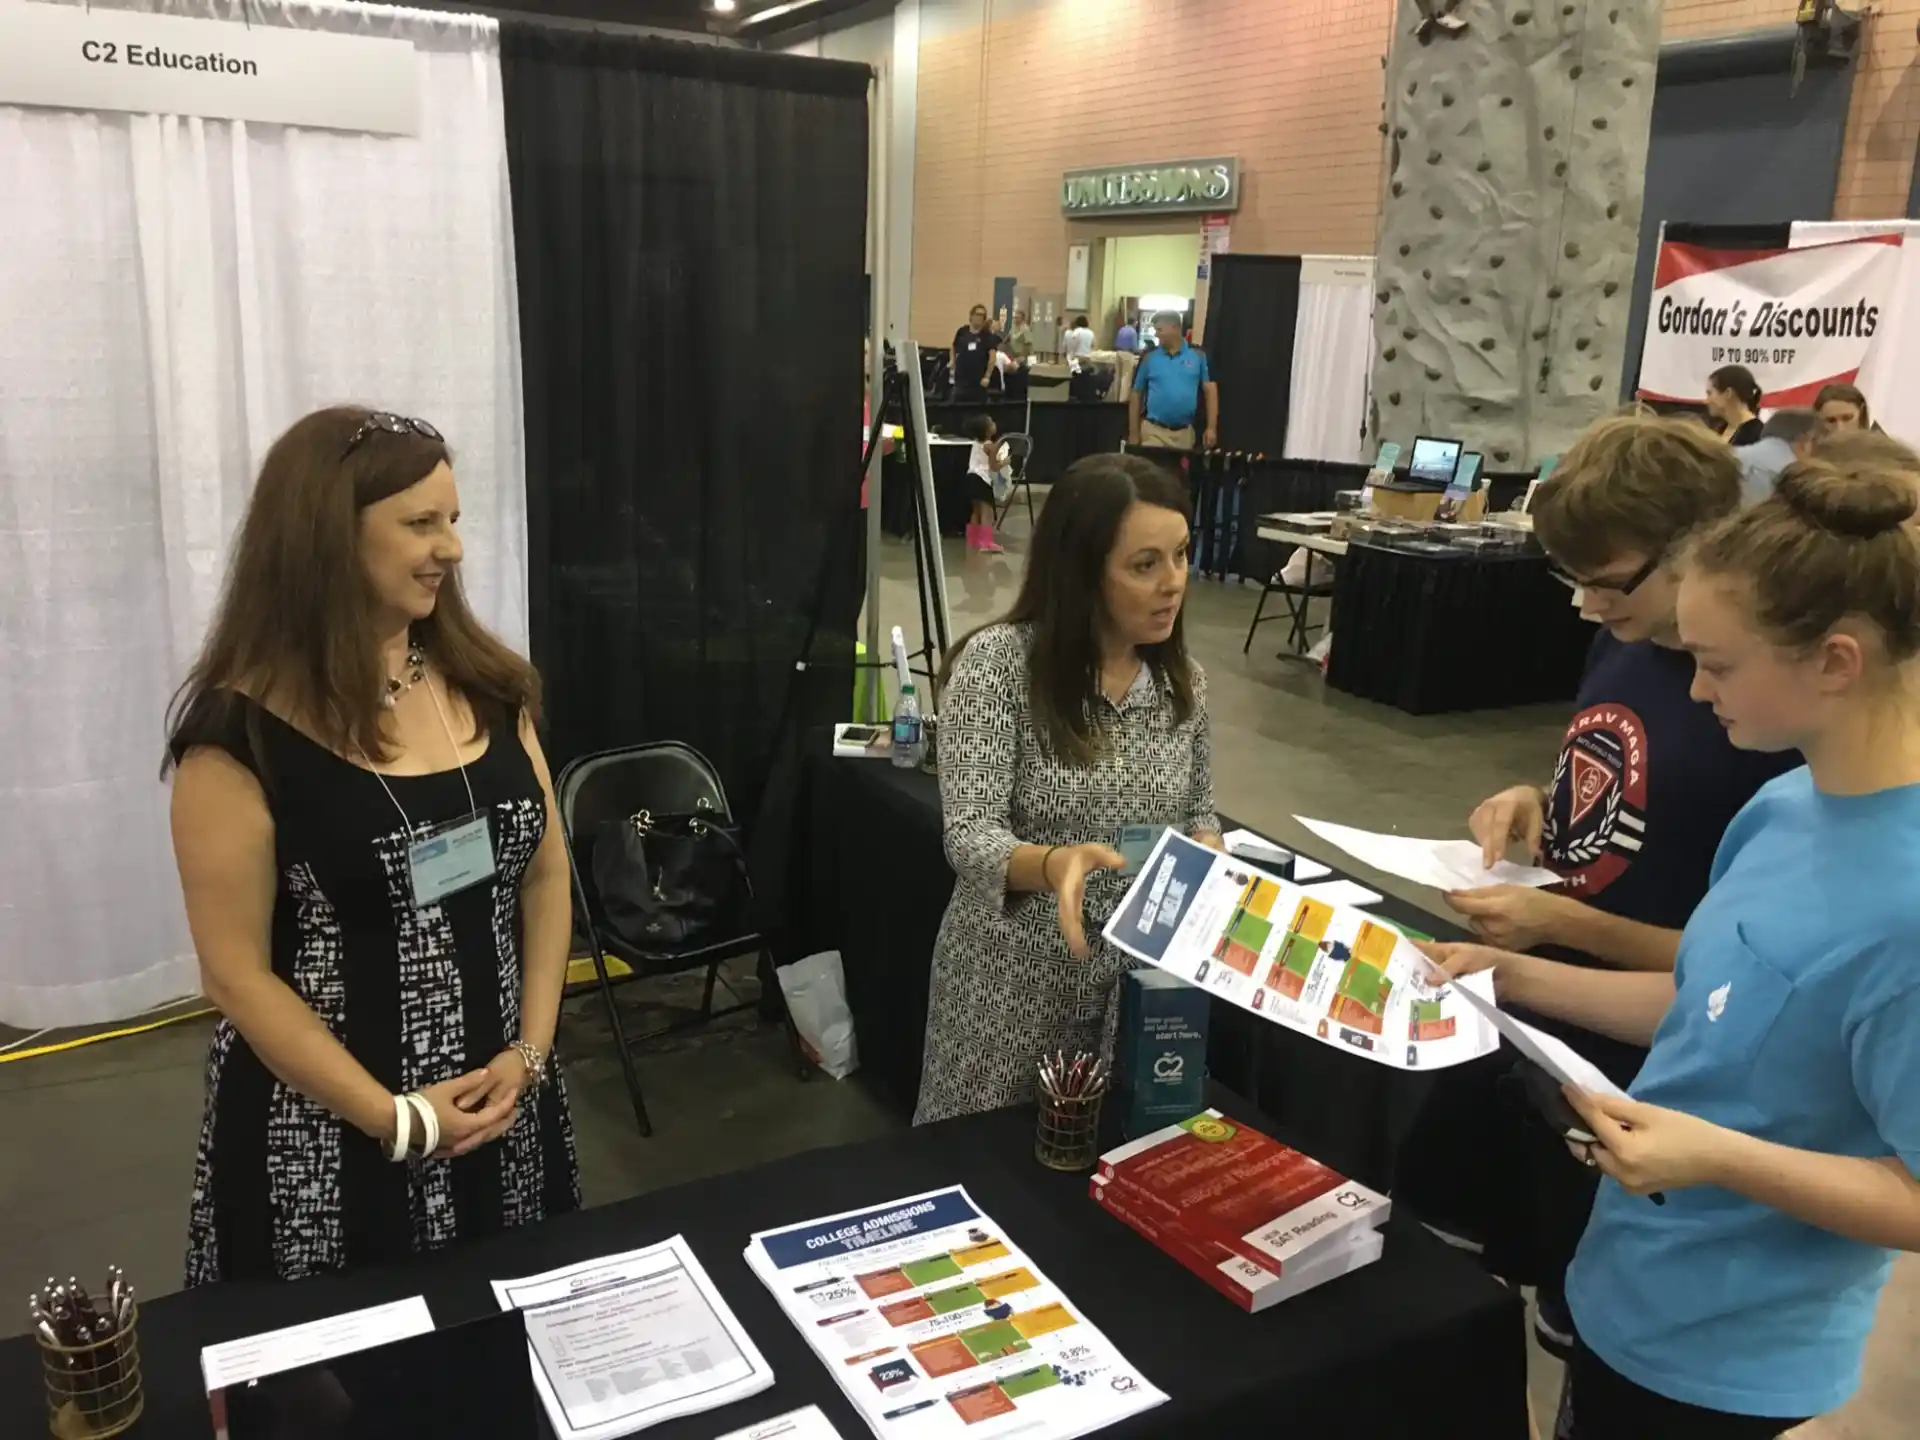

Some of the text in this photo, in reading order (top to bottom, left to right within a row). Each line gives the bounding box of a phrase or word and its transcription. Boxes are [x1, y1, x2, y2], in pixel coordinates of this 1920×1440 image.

[81, 40, 258, 76] C2 Education
[1658, 296, 1879, 338] Gordon's Discounts
[1711, 347, 1796, 364] UP TO 90% OFF
[1567, 711, 1640, 788] KRAV MAGA
[1154, 1054, 1184, 1078] C2
[805, 1224, 863, 1250] COLLEGE
[862, 1200, 937, 1235] ADMISSIONS
[840, 1218, 919, 1251] TIMELINE
[1270, 1226, 1294, 1248] SAT
[825, 1286, 858, 1301] 25%
